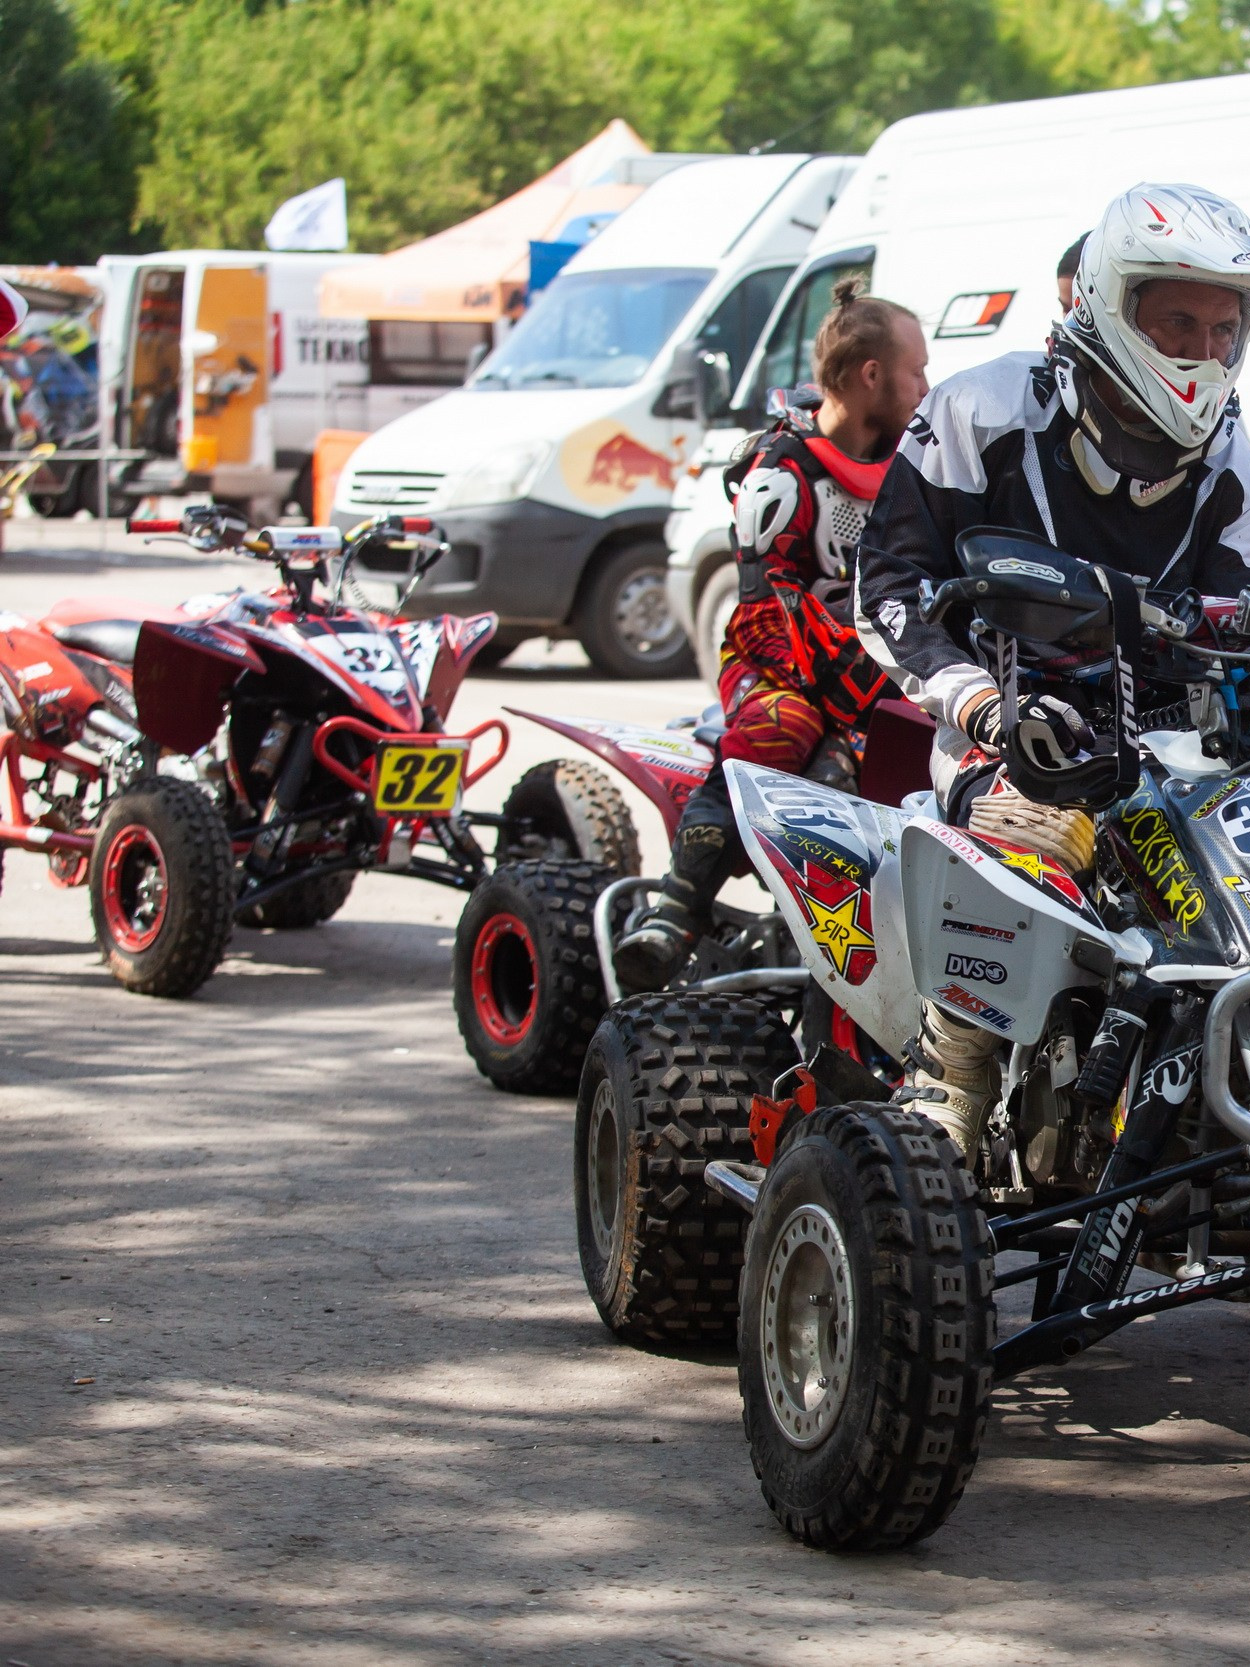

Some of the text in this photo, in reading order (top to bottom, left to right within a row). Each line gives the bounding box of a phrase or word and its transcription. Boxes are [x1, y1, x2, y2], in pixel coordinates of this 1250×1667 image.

[1117, 644, 1140, 750] thor
[382, 754, 457, 804] 32
[927, 822, 985, 865] HONDA
[942, 919, 1015, 940] PROMOTO
[947, 955, 986, 979] DVS
[938, 983, 1013, 1030] AMSOIL
[1133, 1044, 1204, 1110] FOX
[1115, 1228, 1144, 1293] EXTRA VOLUME
[1108, 1266, 1247, 1311] HOUSER
